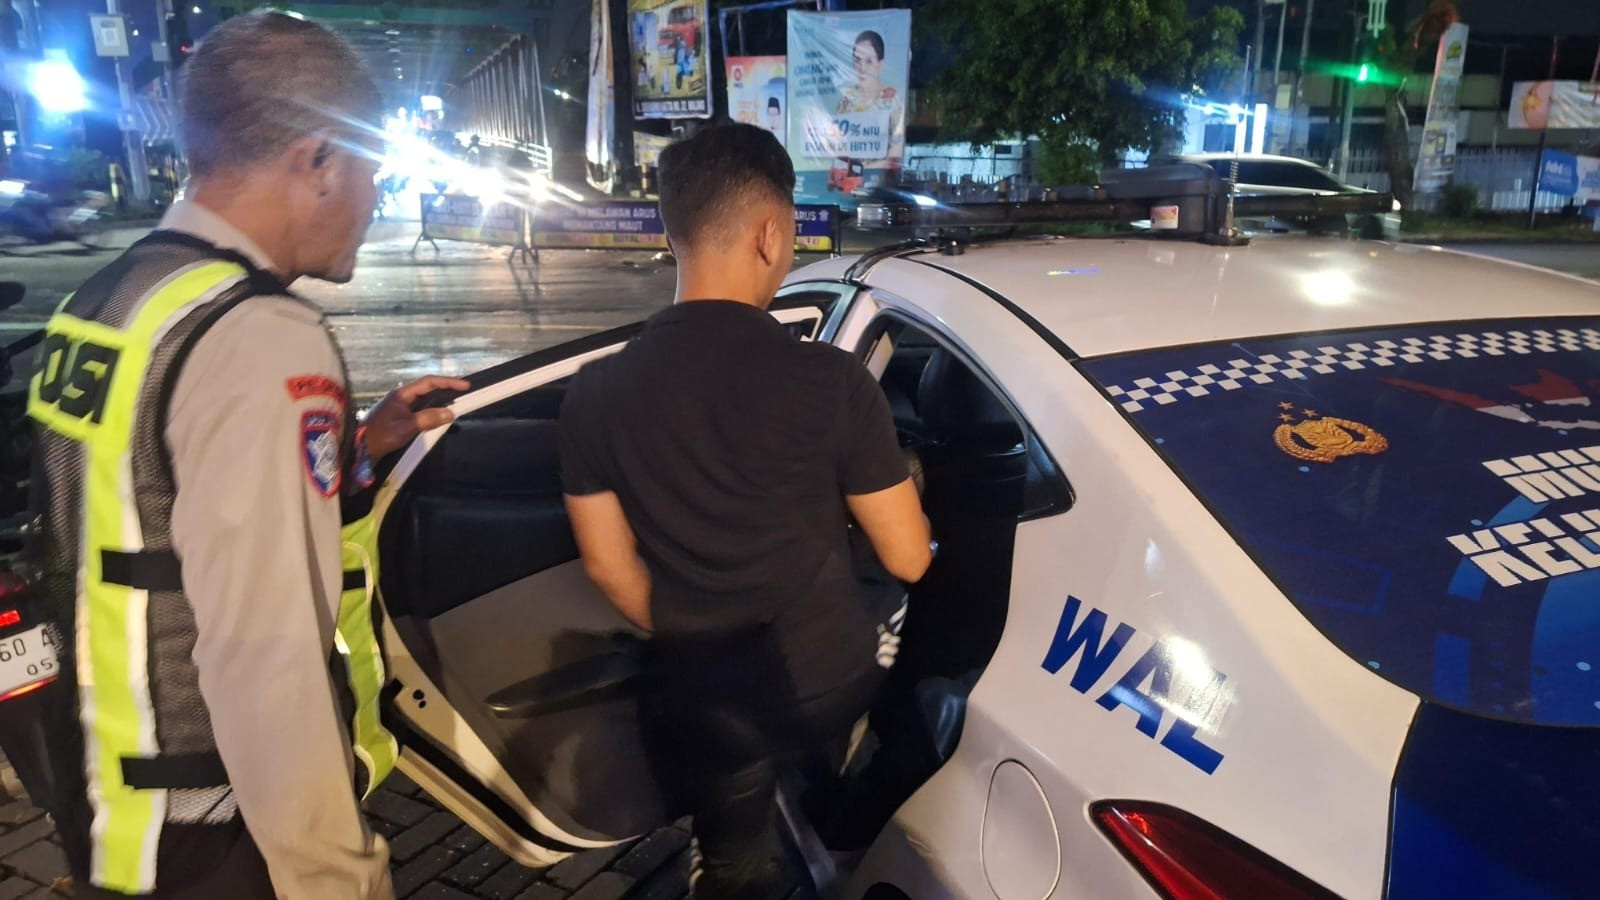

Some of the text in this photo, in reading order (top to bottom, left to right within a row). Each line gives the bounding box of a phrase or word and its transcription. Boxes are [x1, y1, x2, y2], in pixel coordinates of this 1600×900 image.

[633, 208, 657, 219] ARUS
[794, 210, 816, 221] ARUS
[618, 221, 643, 232] MAUT
[27, 657, 53, 676] 05
[1041, 594, 1227, 776] WAL
